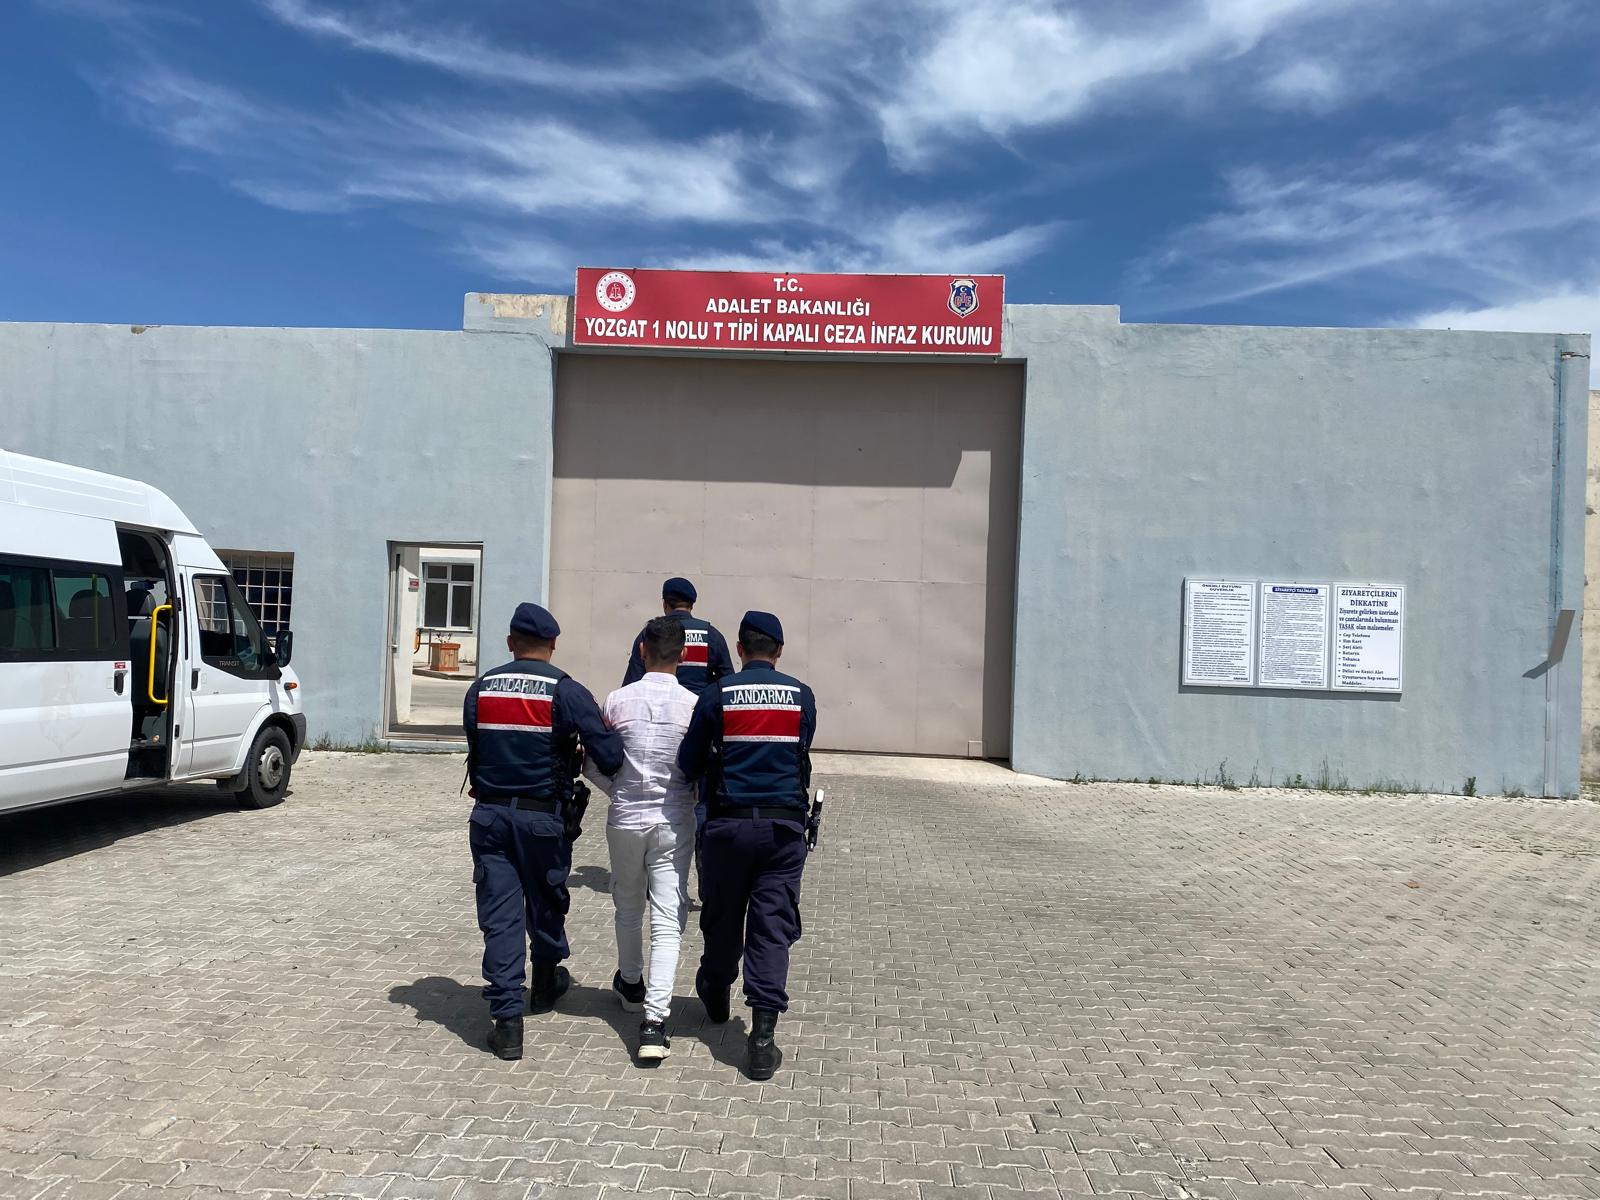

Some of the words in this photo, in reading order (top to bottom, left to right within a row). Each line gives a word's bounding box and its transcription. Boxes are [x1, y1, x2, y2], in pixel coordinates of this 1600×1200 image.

[773, 277, 804, 292] T.C.
[706, 298, 771, 314] ADALET
[777, 298, 870, 317] BAKANLIĞI
[585, 317, 648, 338] YOZGAT
[652, 320, 660, 339] 1
[665, 320, 709, 340] NOLU
[714, 322, 724, 341] T
[728, 318, 758, 342] TİPİ
[763, 322, 819, 343] KAPALI
[824, 324, 866, 344] CEZA
[871, 321, 917, 345] İNFAZ
[921, 325, 993, 346] KURUMU
[1341, 589, 1398, 598] ZİYARETÇİLERİN
[1350, 598, 1389, 607] DİKKATİNE
[485, 677, 547, 695] JANDARMA
[729, 688, 795, 705] JANDARMA
